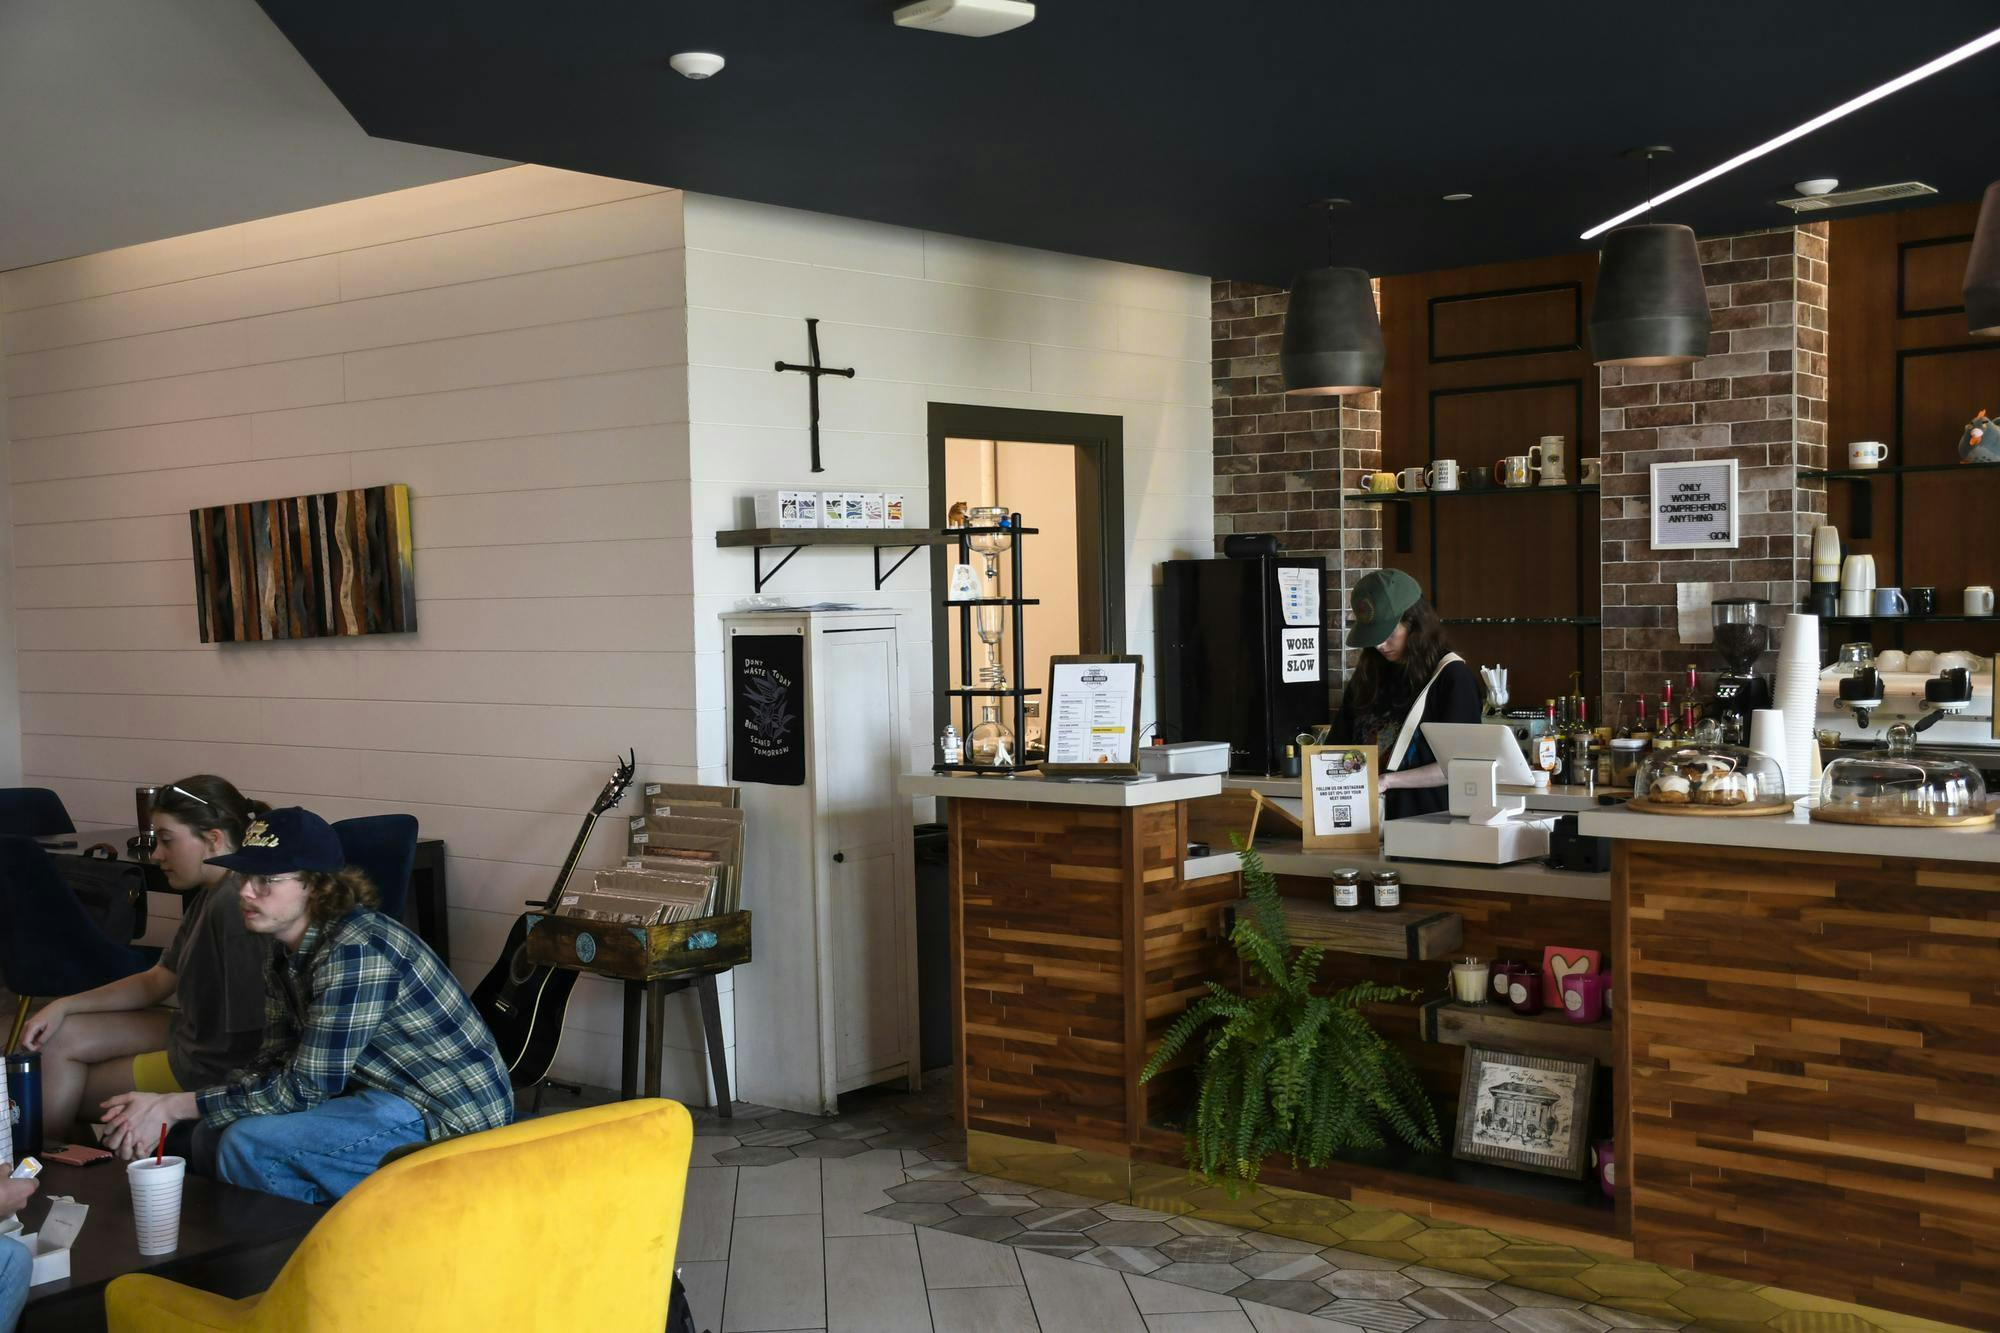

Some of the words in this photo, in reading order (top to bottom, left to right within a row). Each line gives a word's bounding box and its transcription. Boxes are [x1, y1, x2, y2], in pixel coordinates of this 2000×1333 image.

[1678, 483, 1702, 492] ONLY
[1671, 494, 1711, 502] WONDER
[1660, 503, 1727, 513] COMPREHENDS
[1668, 514, 1714, 523] ANYTHING
[1286, 638, 1315, 650] WORK
[1286, 659, 1315, 672] SLOW
[743, 667, 766, 676] WASTE
[772, 669, 792, 688] TODAY
[744, 719, 759, 731] BEING
[750, 735, 771, 747] SCARED
[752, 746, 789, 757] TOMORROW
